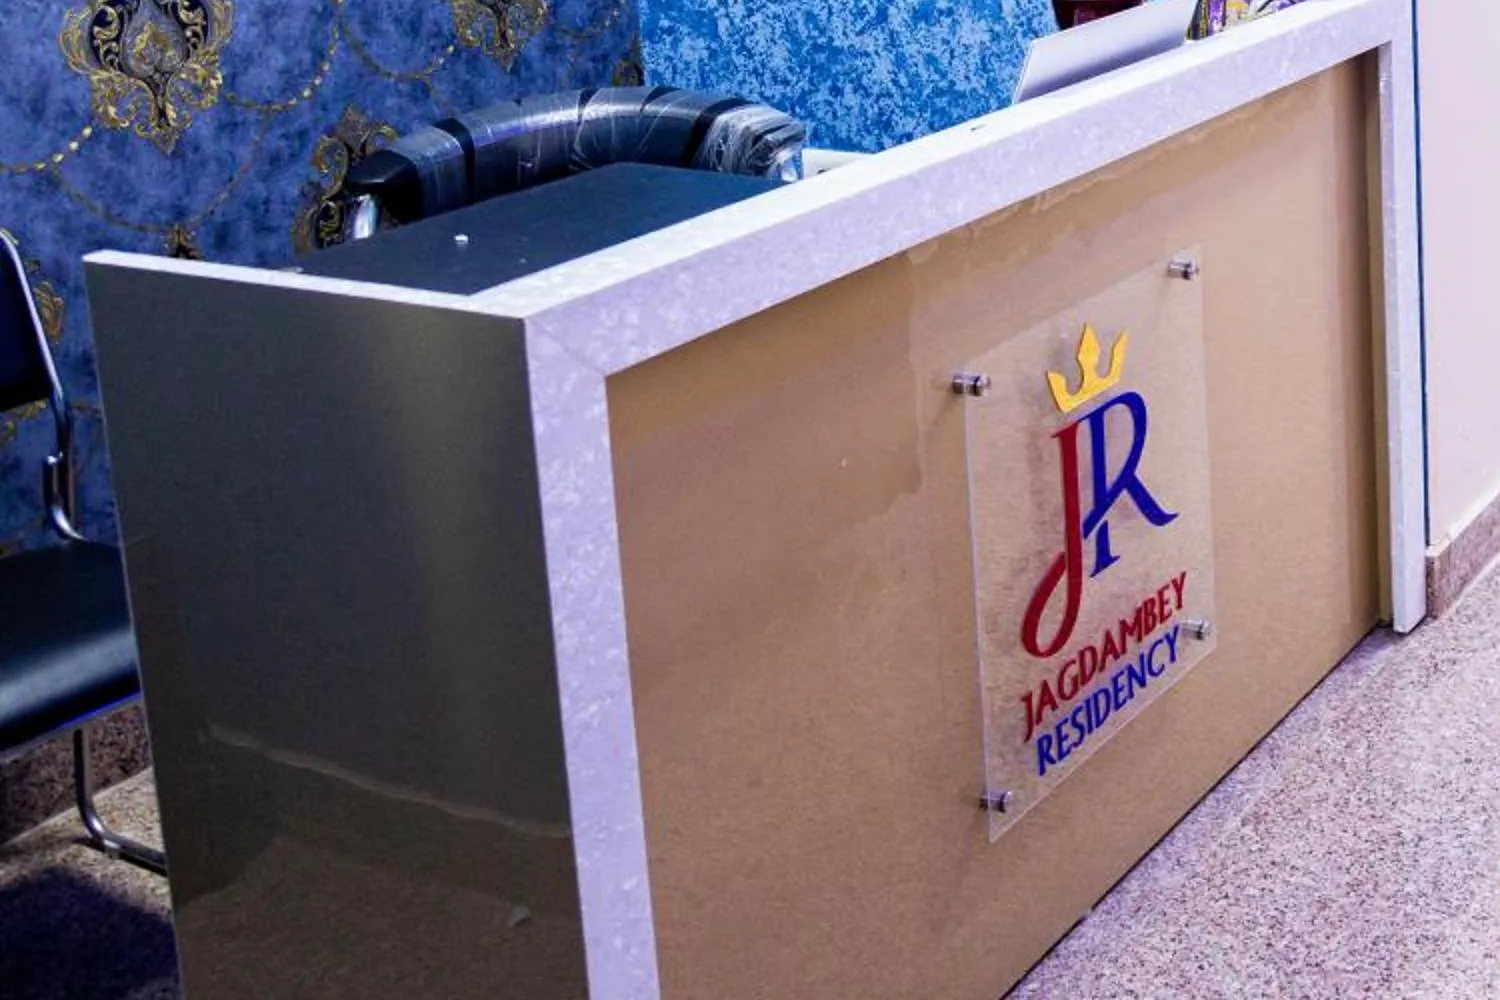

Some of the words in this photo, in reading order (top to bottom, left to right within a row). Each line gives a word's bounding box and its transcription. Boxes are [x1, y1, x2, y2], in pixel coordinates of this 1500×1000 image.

[1020, 391, 1180, 657] JR
[1021, 571, 1187, 743] JAGDAMBEY
[1036, 624, 1180, 776] RESIDENCY
